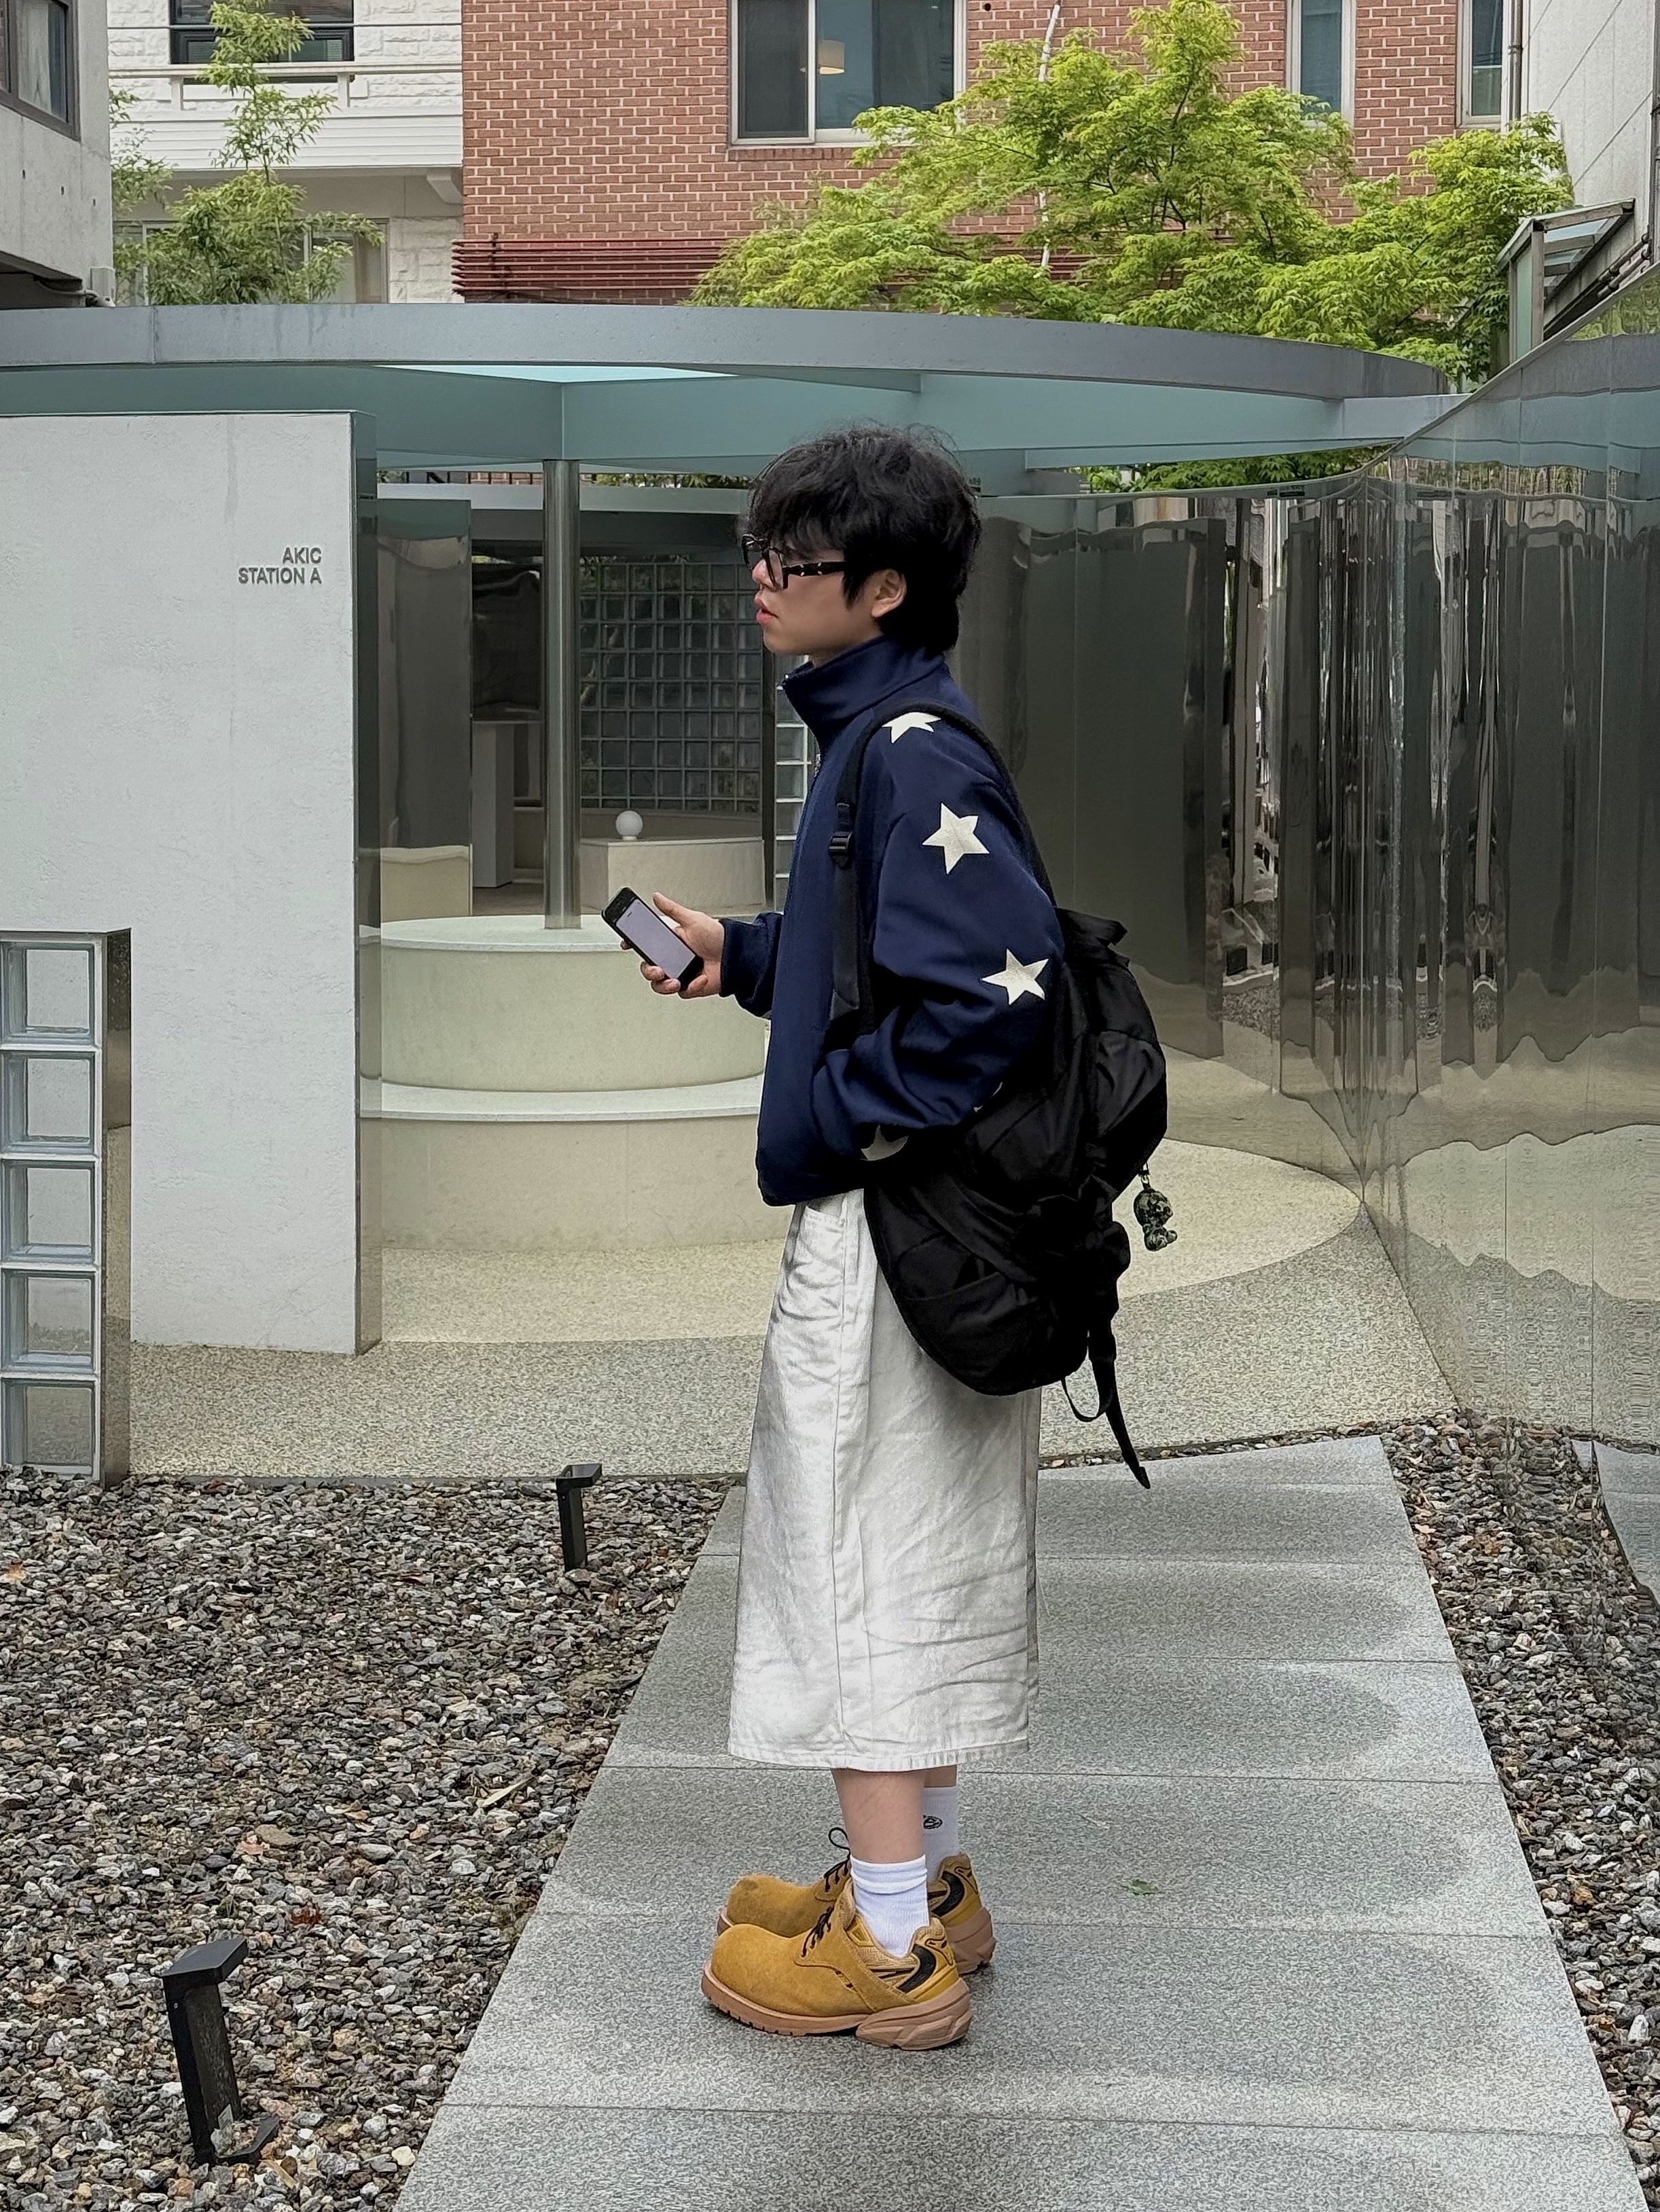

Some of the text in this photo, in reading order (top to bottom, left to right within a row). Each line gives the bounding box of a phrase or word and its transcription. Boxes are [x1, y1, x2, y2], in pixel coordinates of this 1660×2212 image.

[282, 547, 322, 564] AKIC
[238, 567, 323, 585] STATION A
